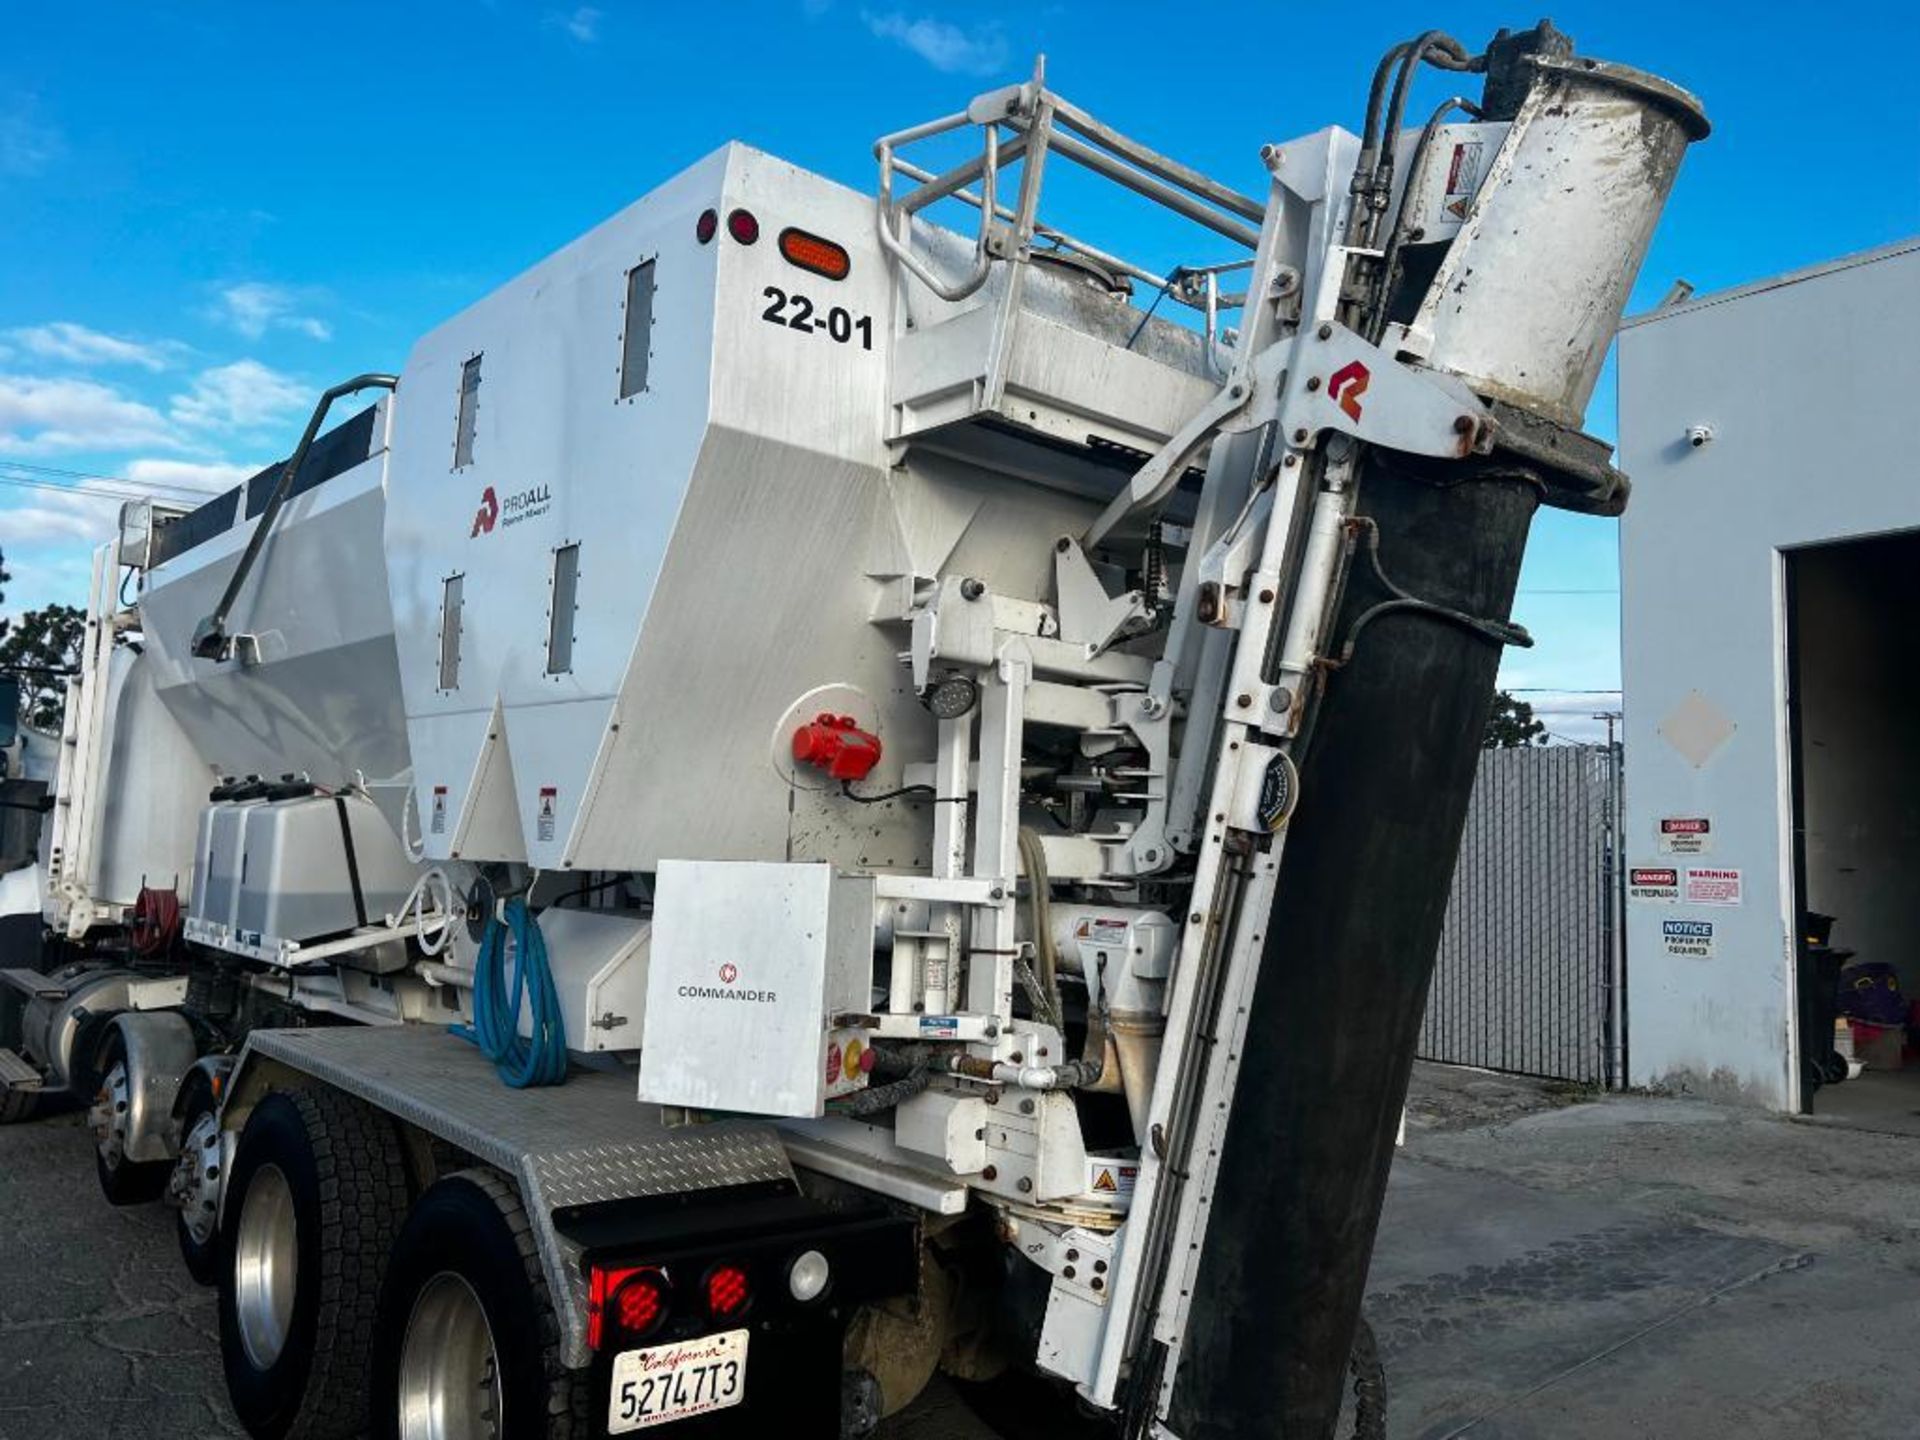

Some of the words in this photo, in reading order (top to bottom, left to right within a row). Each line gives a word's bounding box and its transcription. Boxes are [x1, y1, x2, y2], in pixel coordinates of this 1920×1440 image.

[762, 286, 872, 350] 22-01
[503, 483, 552, 515] PROALL
[1636, 873, 1670, 882] DANGER
[1689, 870, 1739, 879] WARNING
[1664, 922, 1711, 935] NOTICE
[1664, 935, 1694, 945] PROPER
[678, 986, 776, 1003] COMMANDER
[642, 1345, 722, 1371] California
[621, 1360, 738, 1419] 52747T3
